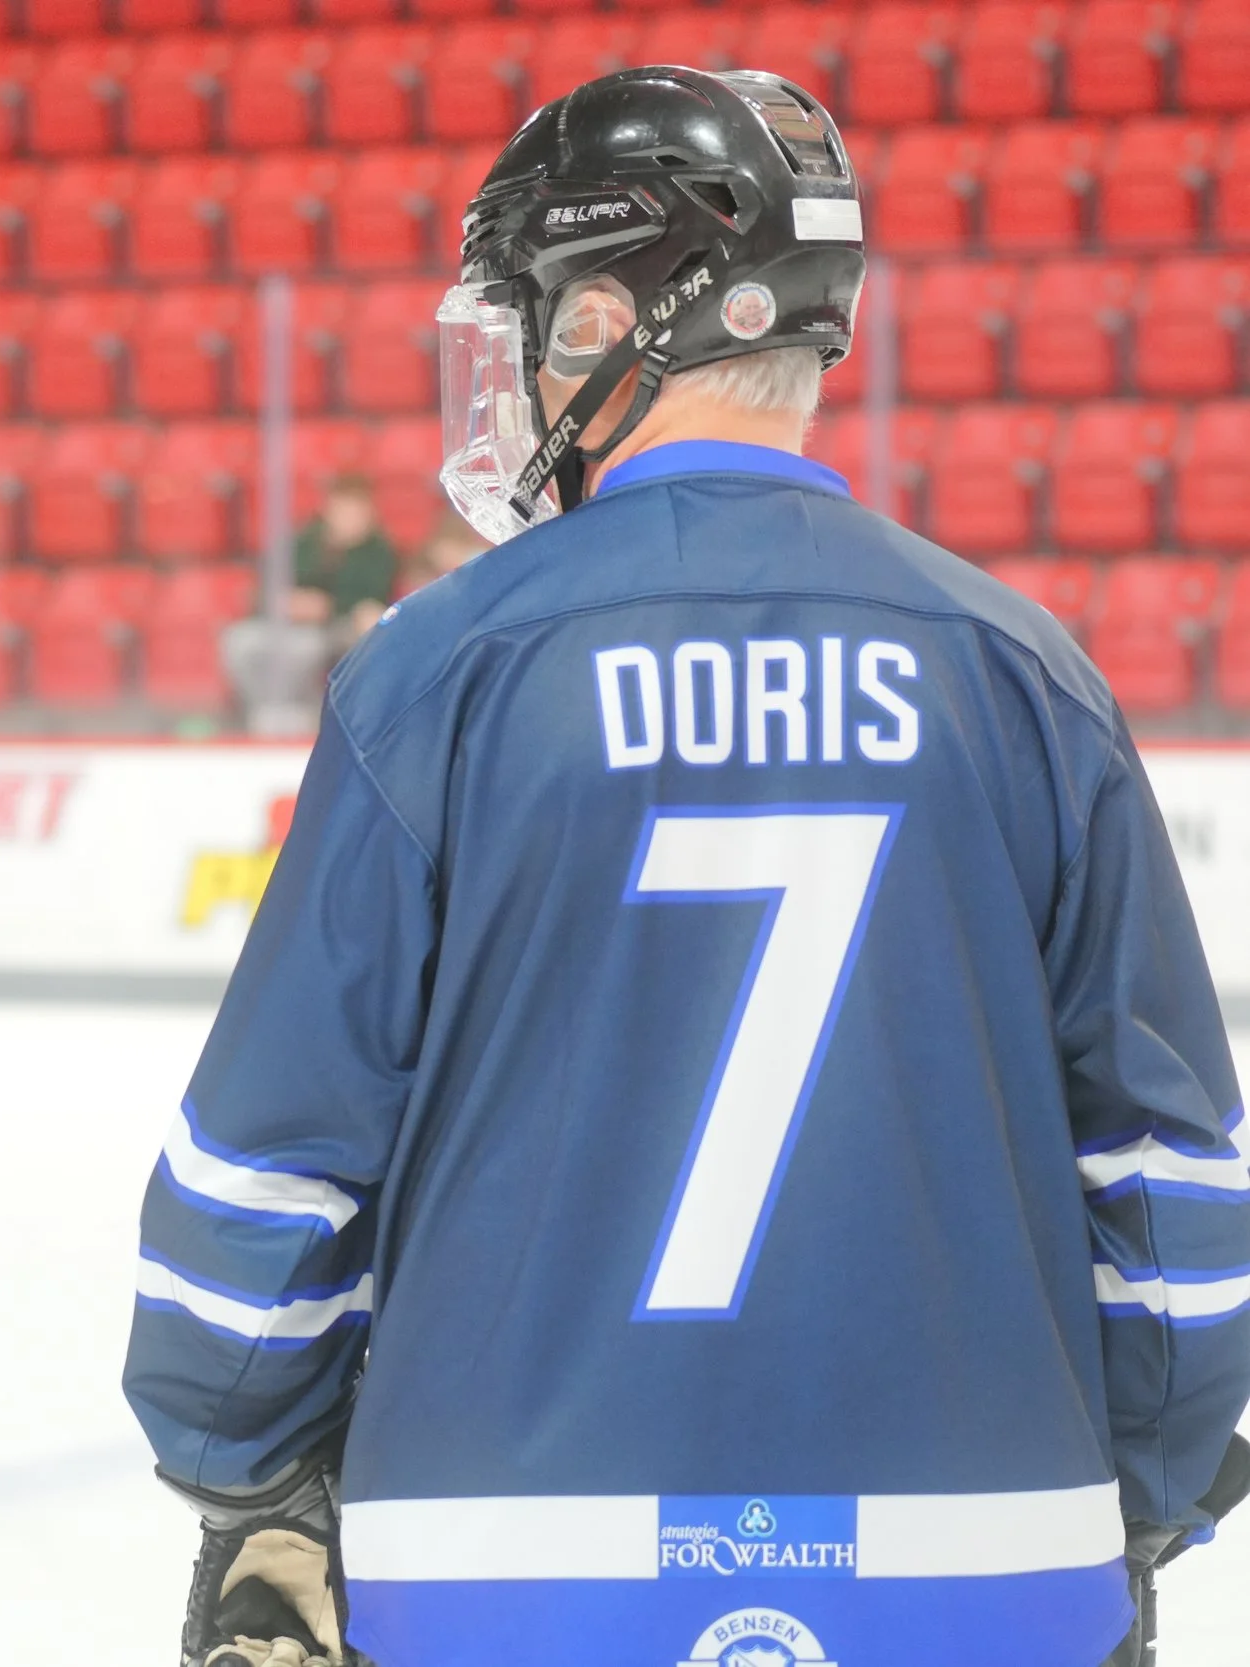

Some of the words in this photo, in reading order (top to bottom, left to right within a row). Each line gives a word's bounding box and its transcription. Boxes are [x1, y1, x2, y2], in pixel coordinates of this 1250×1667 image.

[593, 635, 922, 770] DORIS
[622, 801, 907, 1322] 7
[660, 1522, 719, 1546] strategies
[713, 1615, 801, 1643] BENSEN
